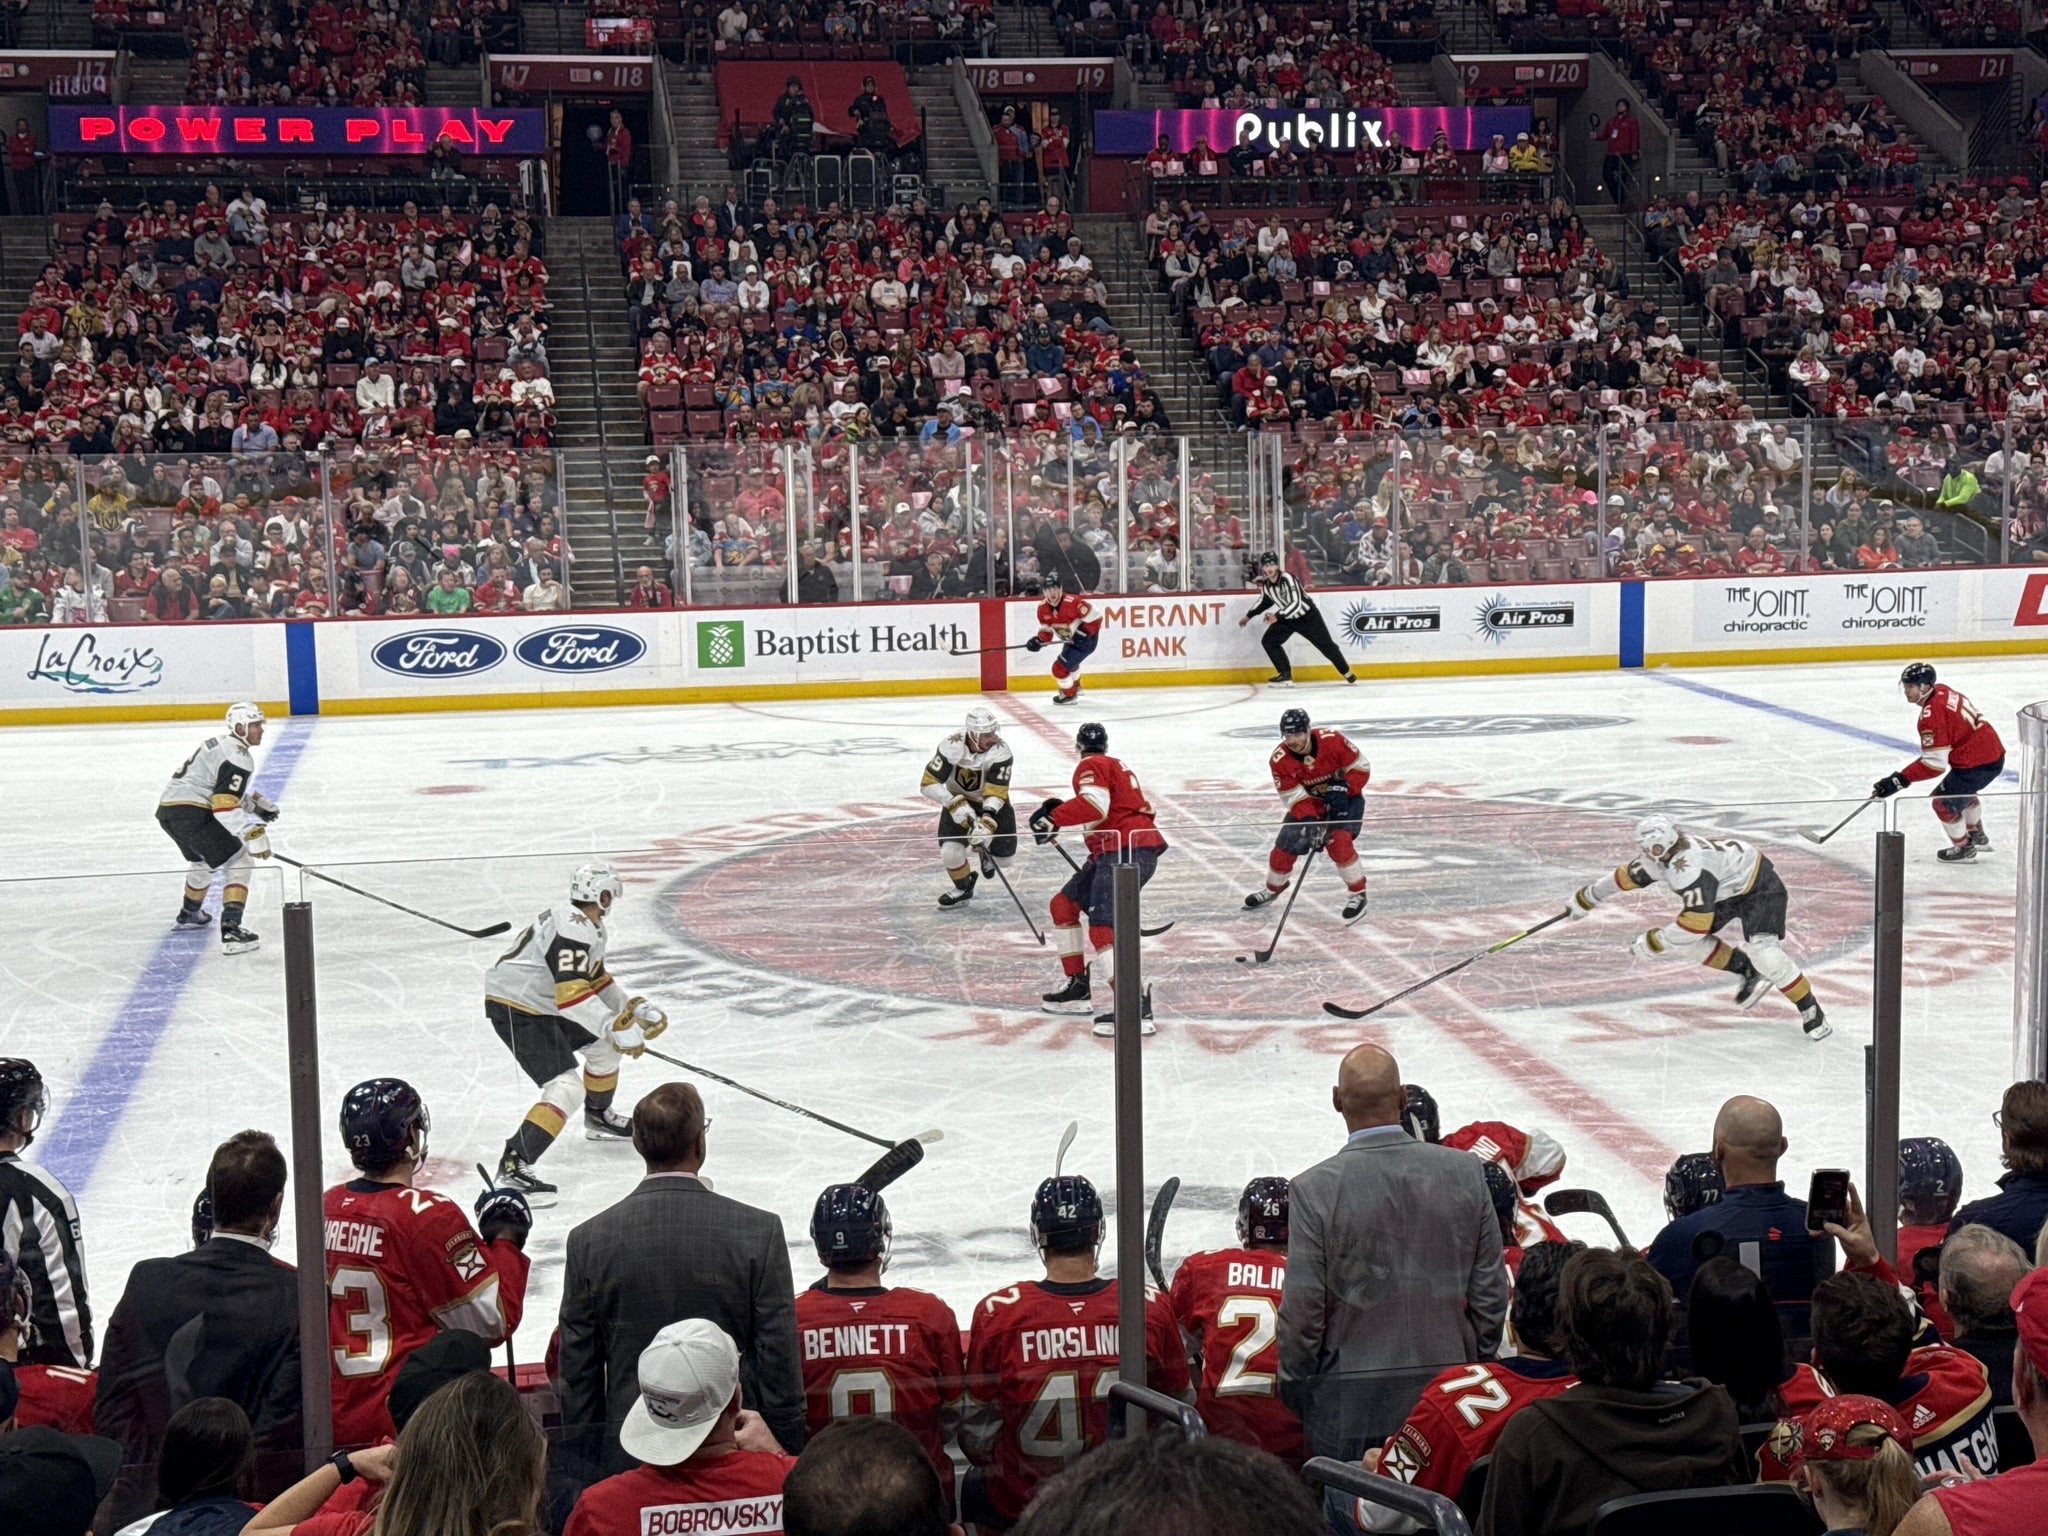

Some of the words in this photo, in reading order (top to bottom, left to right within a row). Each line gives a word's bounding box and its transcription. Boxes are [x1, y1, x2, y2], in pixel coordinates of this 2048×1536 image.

[614, 67, 643, 87] 118
[1076, 68, 1105, 88] 119
[1550, 64, 1580, 83] 120
[1980, 58, 2005, 77] 121
[80, 117, 314, 142] POWER
[345, 119, 515, 143] PLAY
[1725, 587, 1751, 602] THE
[1748, 589, 1810, 618] JOINT
[1843, 584, 1869, 599] THE
[1865, 586, 1928, 614] JOINT
[1101, 603, 1226, 629] MERANT
[1363, 616, 1391, 631] Air
[1394, 615, 1432, 630] Pros
[1498, 612, 1526, 626] Air
[1529, 611, 1566, 625] Pros
[1723, 618, 1809, 634] chiropractic
[1842, 615, 1926, 630] chiropractic
[399, 636, 480, 669] Ford
[540, 633, 620, 664] Ford
[754, 627, 861, 663] Baptist
[870, 623, 969, 652] Health
[1121, 636, 1187, 658] BANK
[228, 773, 243, 792] 3
[558, 948, 590, 973] 27
[353, 1133, 371, 1148] 23
[1702, 1188, 1718, 1203] 77
[1057, 1204, 1077, 1219] 42
[1263, 1203, 1280, 1217] 26
[325, 1220, 385, 1258] HAEGHE
[835, 1231, 845, 1246] 9
[1227, 1262, 1285, 1290] BALIN
[803, 1324, 910, 1361] BENNETT
[1439, 1364, 1512, 1429] 72
[650, 1500, 783, 1536] BOBROVSKY
